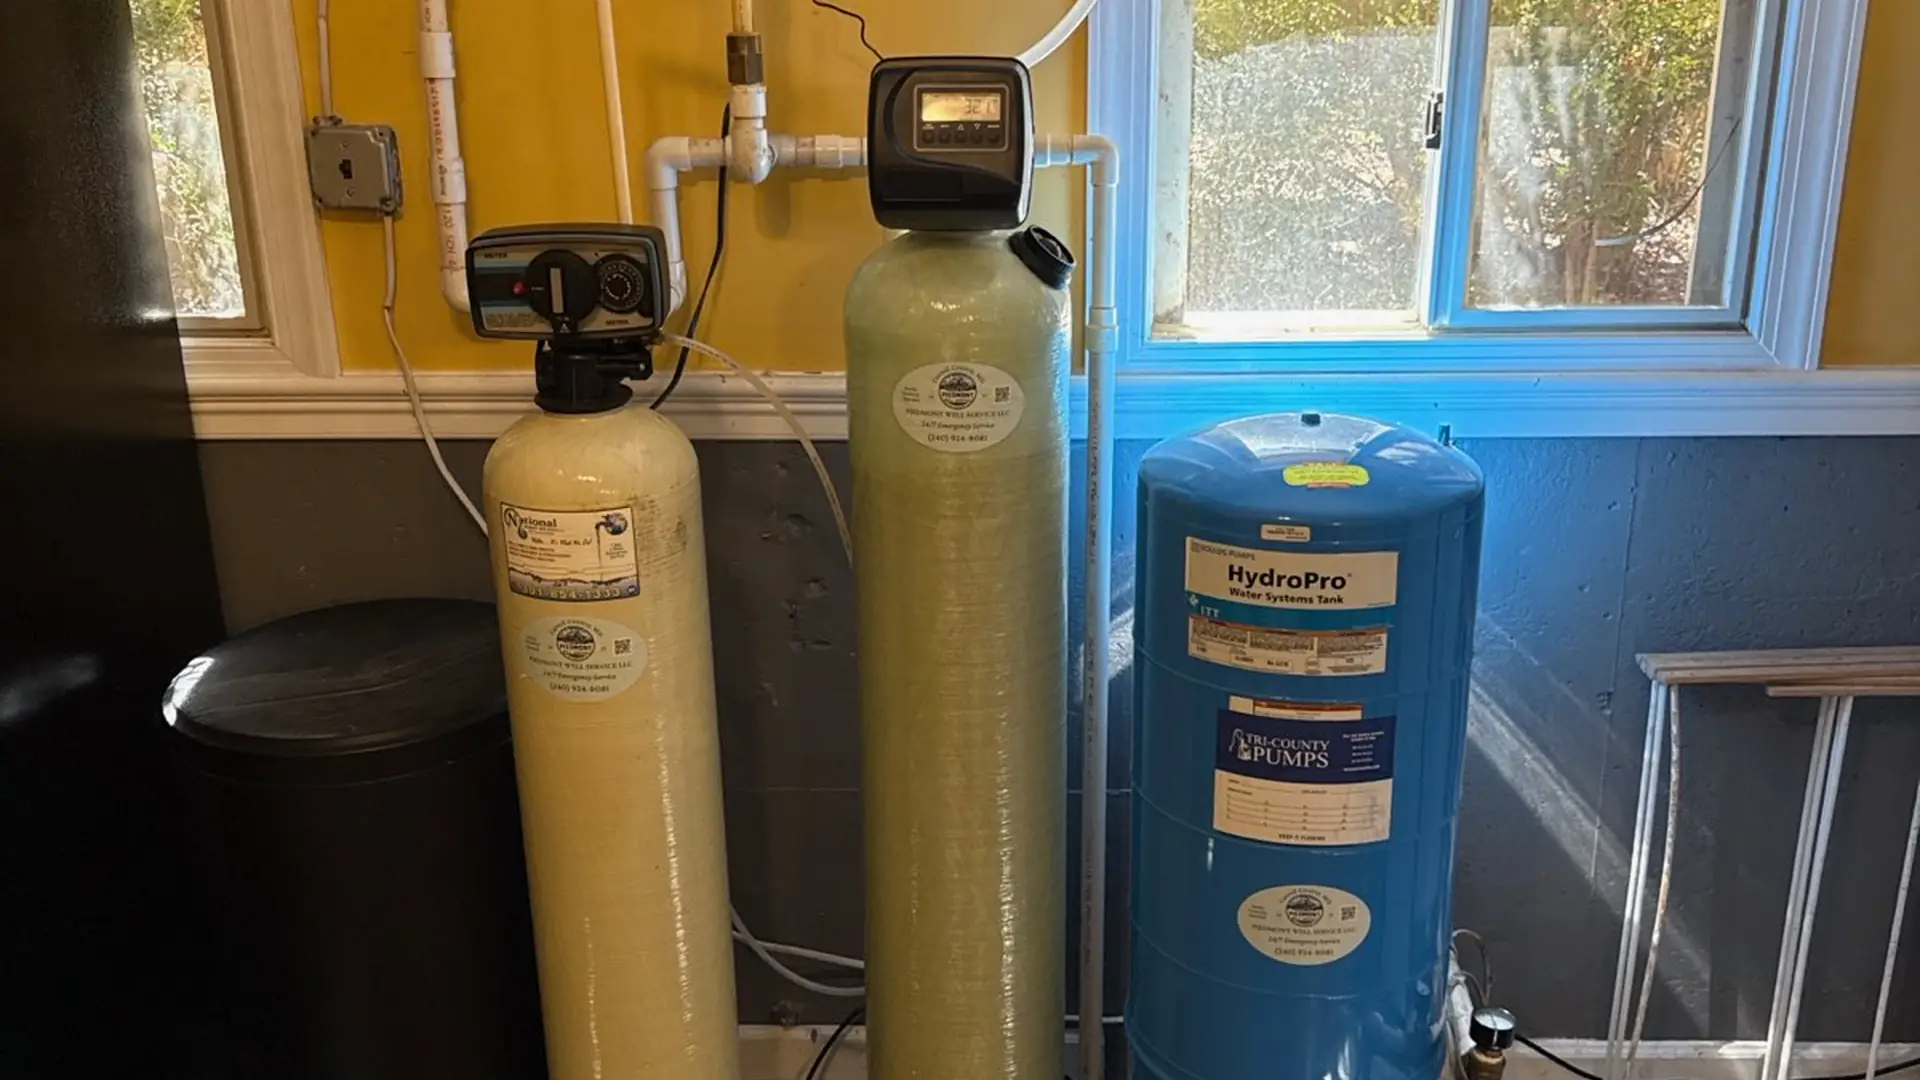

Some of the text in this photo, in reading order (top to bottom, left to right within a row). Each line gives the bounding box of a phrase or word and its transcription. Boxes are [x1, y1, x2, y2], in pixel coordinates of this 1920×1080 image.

[1228, 564, 1346, 590] HydroPro
[1228, 587, 1344, 605] Water Systems Tank
[1201, 606, 1220, 618] ITT
[1245, 733, 1331, 751] TRI-COUNTY
[1253, 747, 1329, 769] PUMPS
